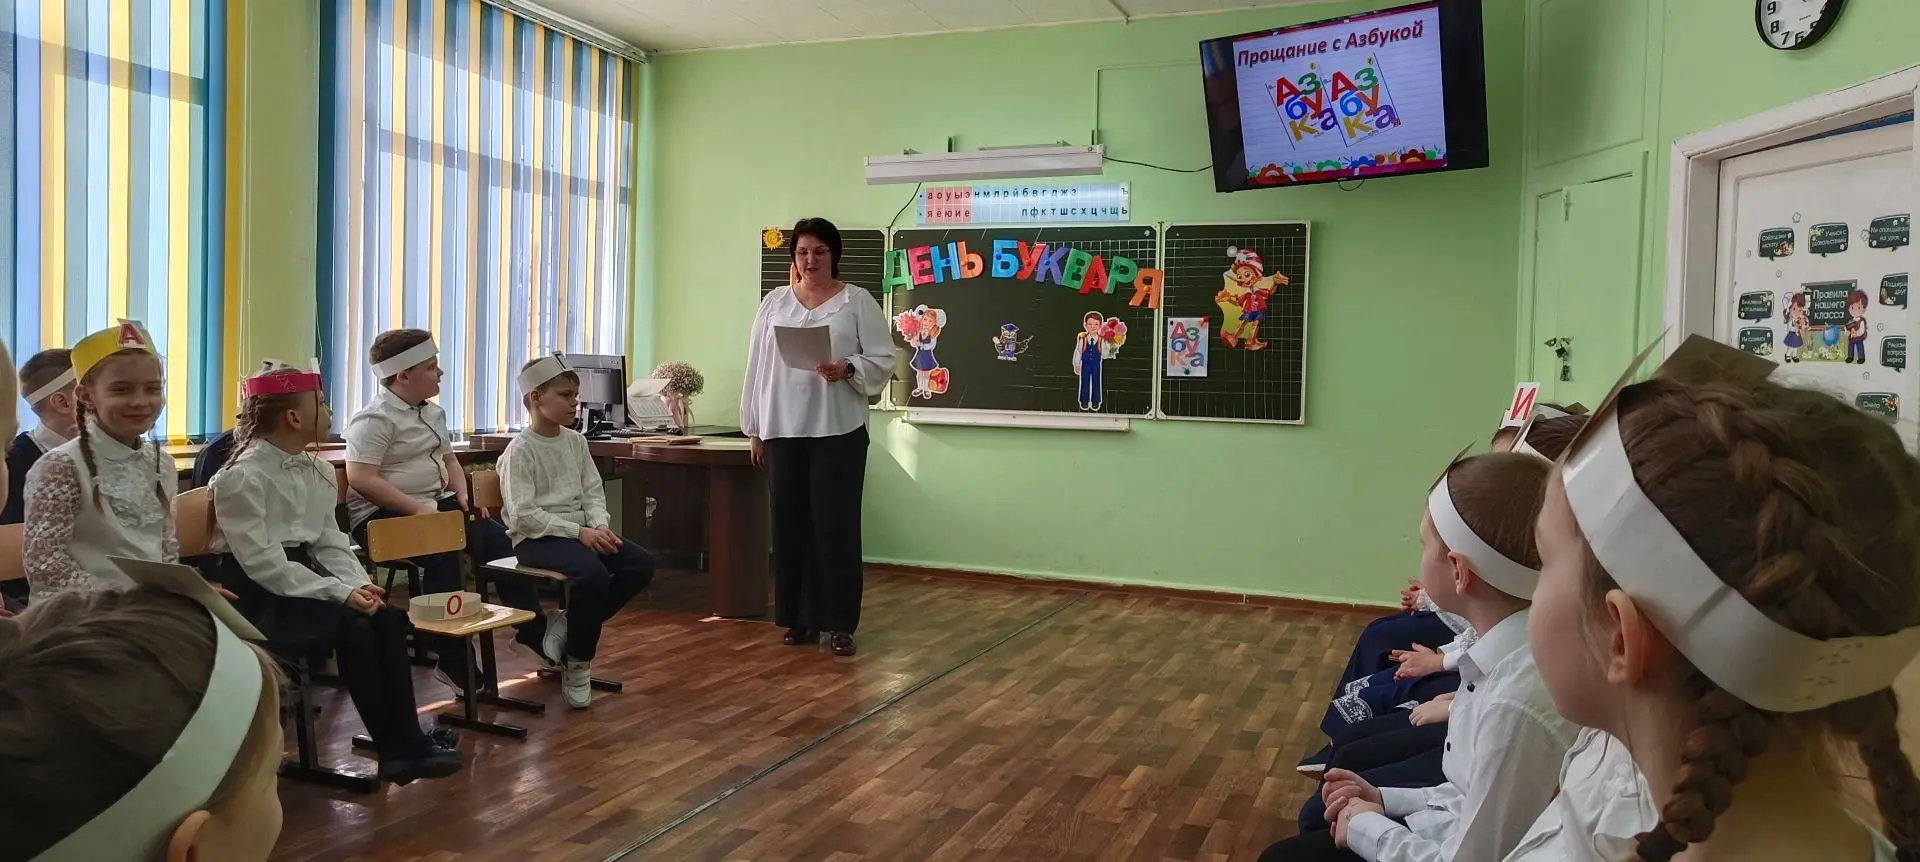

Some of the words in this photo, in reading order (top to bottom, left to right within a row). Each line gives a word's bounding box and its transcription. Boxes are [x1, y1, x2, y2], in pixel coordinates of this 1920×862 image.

[1767, 1, 1776, 15] 9
[1770, 20, 1779, 34] 8
[1237, 39, 1327, 68] Прощание
[1332, 39, 1341, 51] с
[1345, 20, 1423, 50] Азбукой
[1781, 31, 1790, 45] 7
[882, 240, 984, 293] ДЕНЬ
[991, 239, 1163, 309] БУКВАРЯ
[1813, 289, 1848, 300] Правила
[1814, 300, 1846, 310] нашего
[1814, 311, 1845, 320] класса
[119, 323, 145, 345] А
[1509, 387, 1537, 421] И
[446, 594, 463, 616] О
